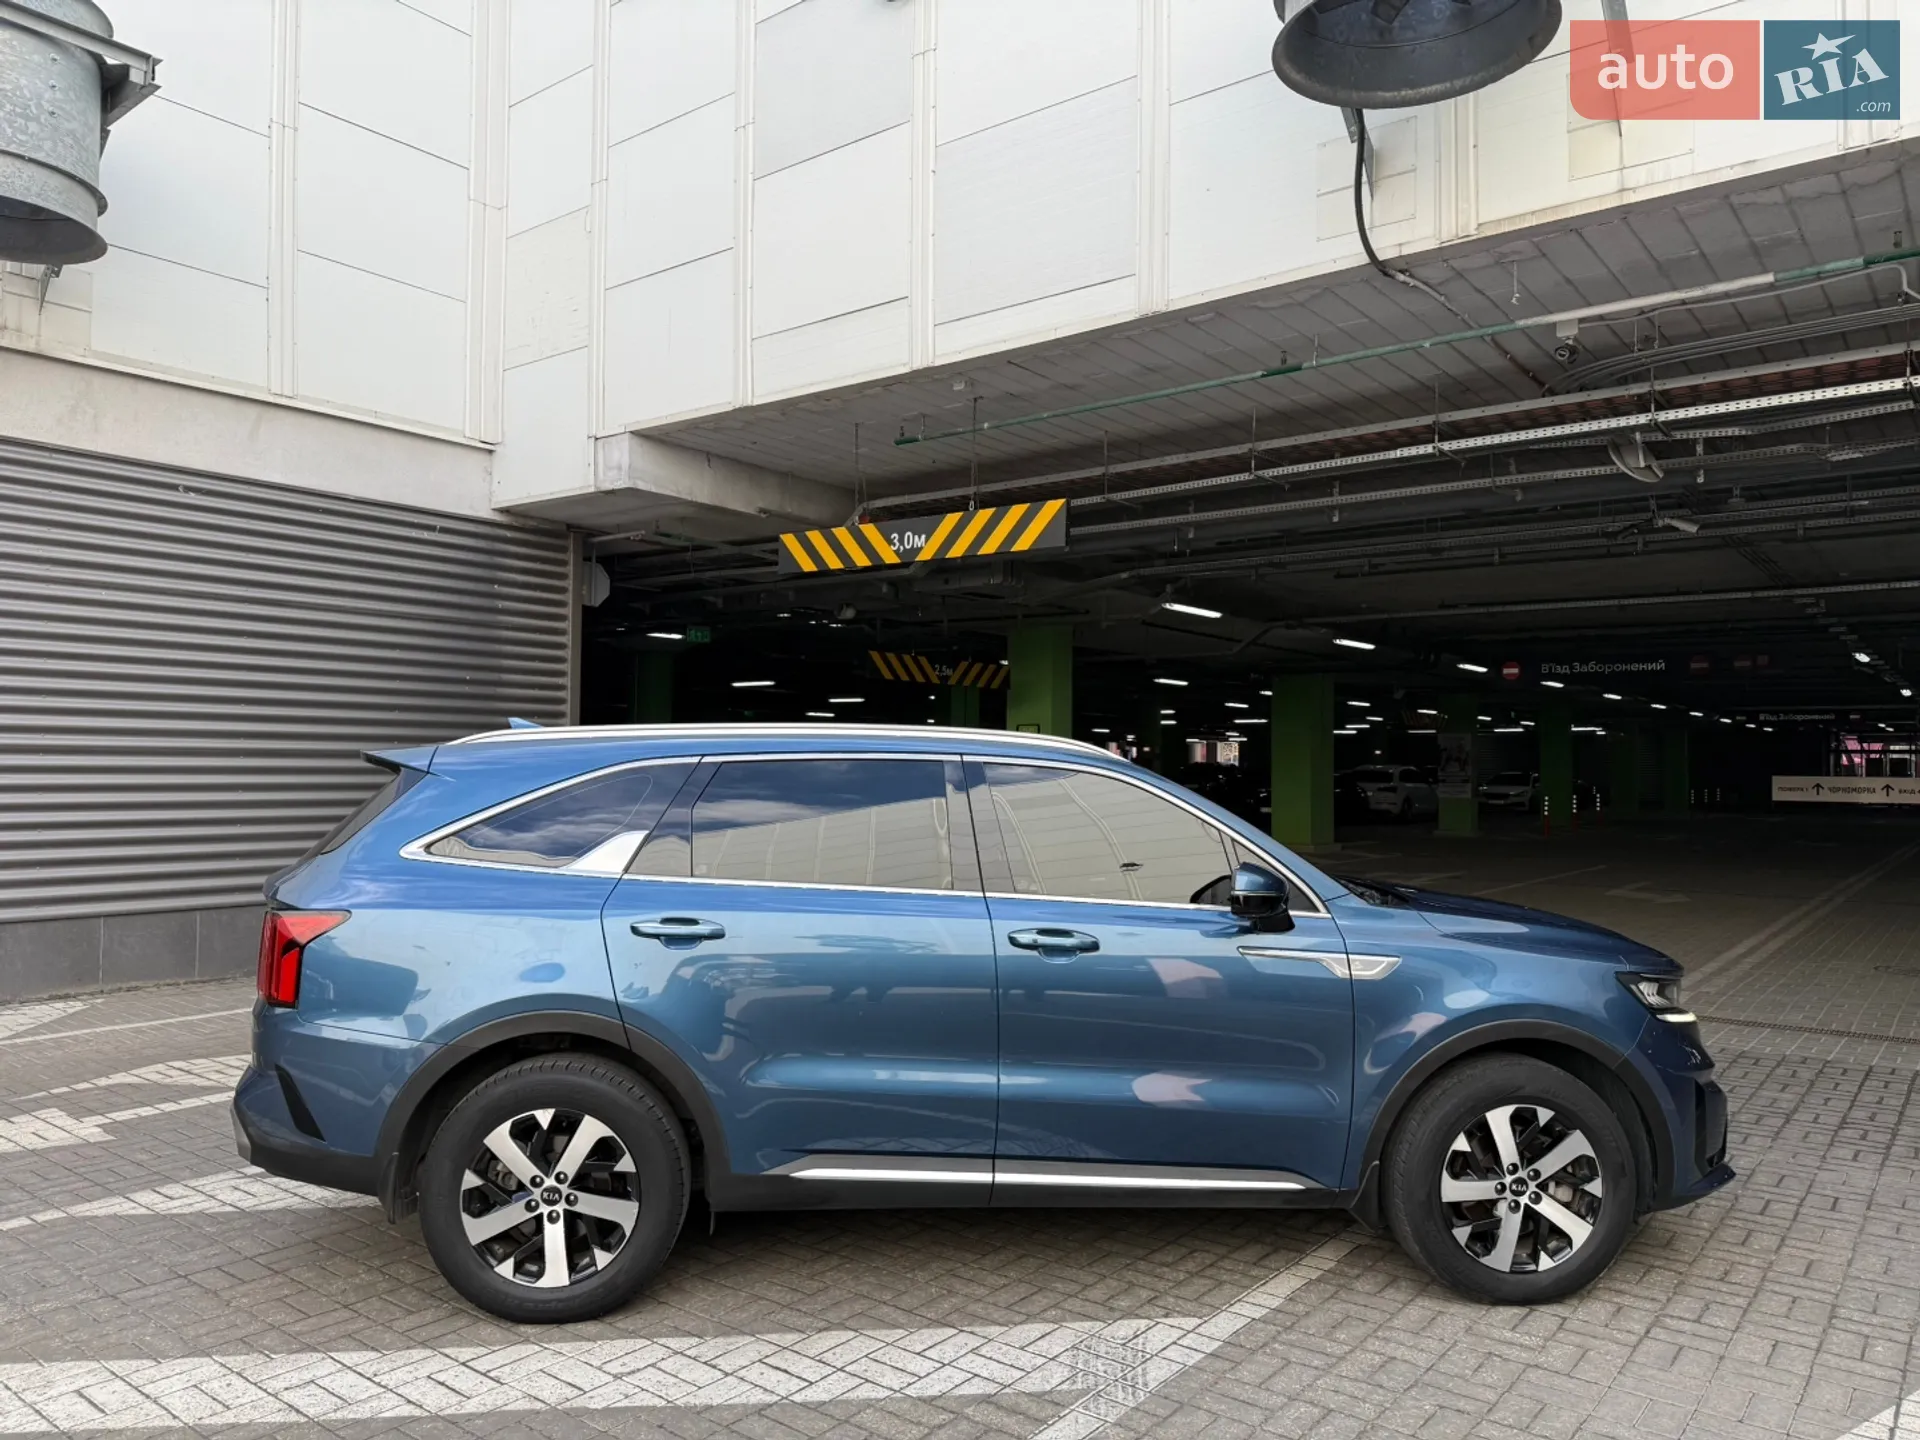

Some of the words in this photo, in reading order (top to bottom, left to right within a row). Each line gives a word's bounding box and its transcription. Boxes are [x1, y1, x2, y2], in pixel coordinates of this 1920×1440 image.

[1572, 660, 1666, 675] Заборонений
[1511, 1183, 1527, 1191] KIA
[542, 1191, 560, 1201] KIA
